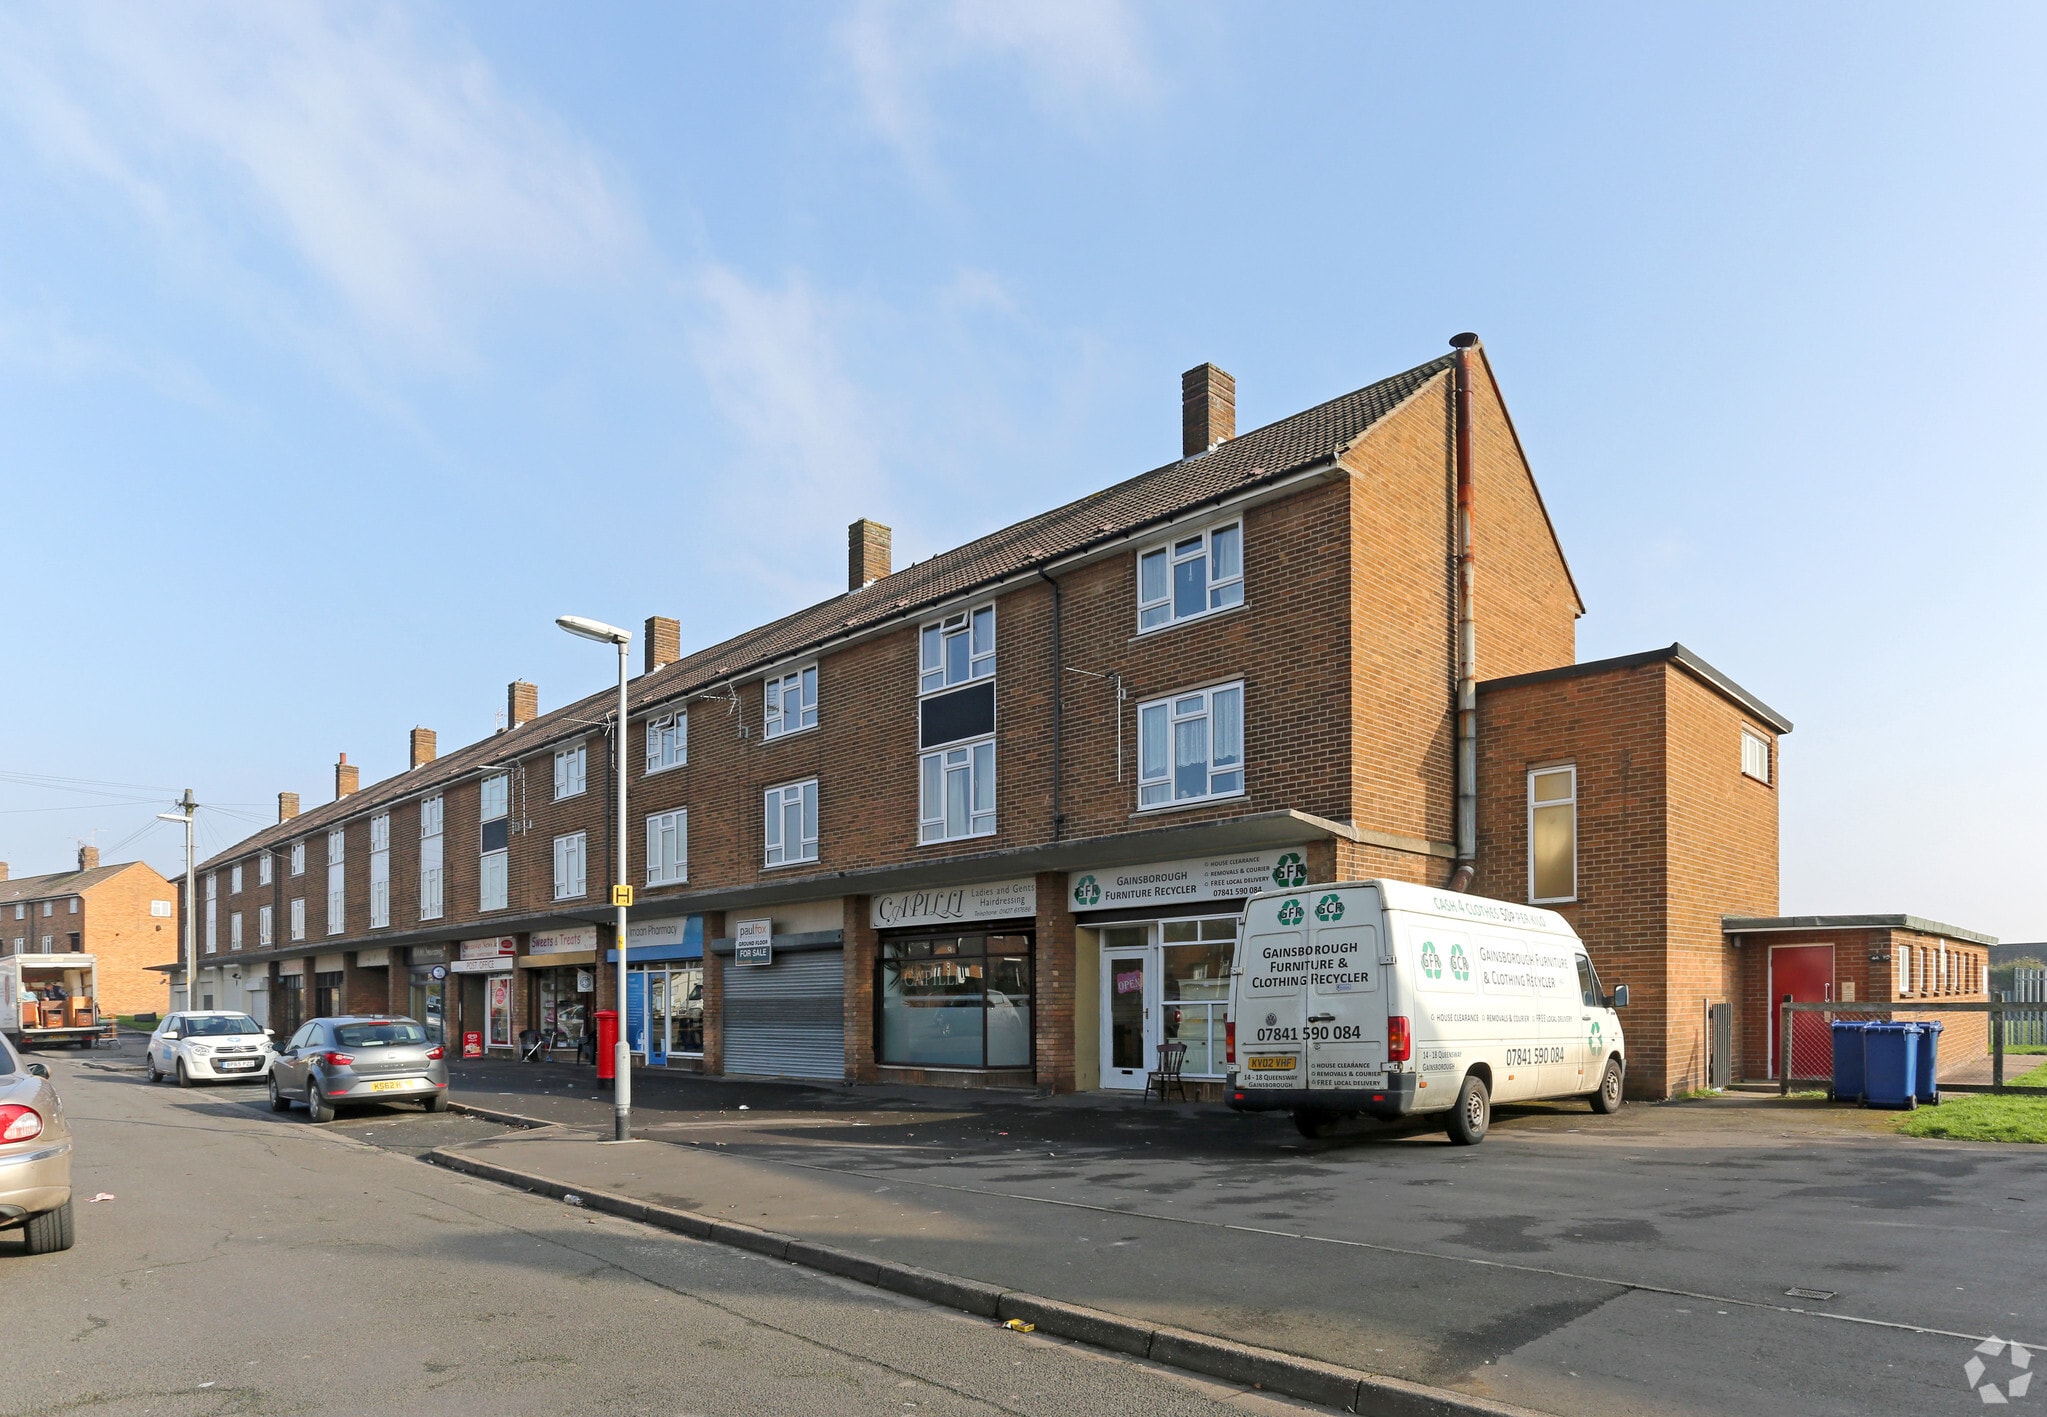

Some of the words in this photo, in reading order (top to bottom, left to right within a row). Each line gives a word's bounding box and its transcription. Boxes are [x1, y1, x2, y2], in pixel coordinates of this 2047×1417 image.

[1230, 857, 1259, 865] CLEARANCE
[1210, 868, 1238, 876] REMOVALS
[1274, 864, 1307, 880] GFR
[1117, 872, 1187, 886] GAINSBOROUGH
[616, 888, 629, 903] H
[972, 888, 993, 897] Ladies
[997, 885, 1010, 894] and
[1013, 884, 1034, 893] Gents
[1077, 884, 1099, 898] GFR
[1105, 888, 1152, 901] FURNITURE
[1154, 884, 1196, 896] RECYCLER
[1249, 886, 1262, 894] 084
[880, 890, 966, 926] CAPILLI
[980, 897, 1025, 906] Hairdressing
[1280, 906, 1302, 919] GFR
[1316, 902, 1343, 915] GCR
[1434, 898, 1458, 912] CASH
[1458, 899, 1464, 912] 4
[1466, 903, 1500, 919] CLOTHES
[648, 925, 677, 936] Pharmacy
[532, 937, 553, 947] Sweets
[560, 934, 581, 944] Treats
[740, 950, 752, 958] FOR
[753, 948, 767, 956] SALE
[1263, 942, 1358, 959] GAINSBOROUGH
[466, 961, 477, 969] POST
[480, 960, 494, 969] OFFICE
[1422, 953, 1442, 969] GFR
[1450, 956, 1469, 971] GCR
[1480, 947, 1534, 966] GAINSBOROUGH
[1535, 953, 1568, 969] FURNITURE
[1270, 958, 1334, 973] FURNITURE
[1338, 957, 1348, 968] &
[1118, 978, 1141, 990] OPEN
[1252, 975, 1307, 988] CLOTHING
[1310, 972, 1369, 985] RECYCLER
[1483, 971, 1490, 984] &
[1492, 970, 1525, 986] CLOTHING
[1526, 974, 1555, 988] RECYCLER
[1437, 1014, 1453, 1022] HOUSE
[1454, 1014, 1479, 1022] CLEARANCE
[1486, 1014, 1508, 1022] REMOVALS
[1536, 1014, 1546, 1022] FREE
[1257, 1027, 1298, 1041] 07841
[1302, 1026, 1329, 1040] 590
[1333, 1025, 1361, 1039] 084
[1423, 1051, 1428, 1059] 14
[1432, 1051, 1437, 1059] 18
[1438, 1050, 1462, 1059] QUEENSWAY
[1506, 1049, 1532, 1066] 07841
[1534, 1048, 1548, 1064] 590
[1550, 1047, 1564, 1063] 084
[1252, 1059, 1274, 1068] KV02
[1276, 1058, 1292, 1067] VHF
[1423, 1063, 1455, 1071] GAINSBOROUGH
